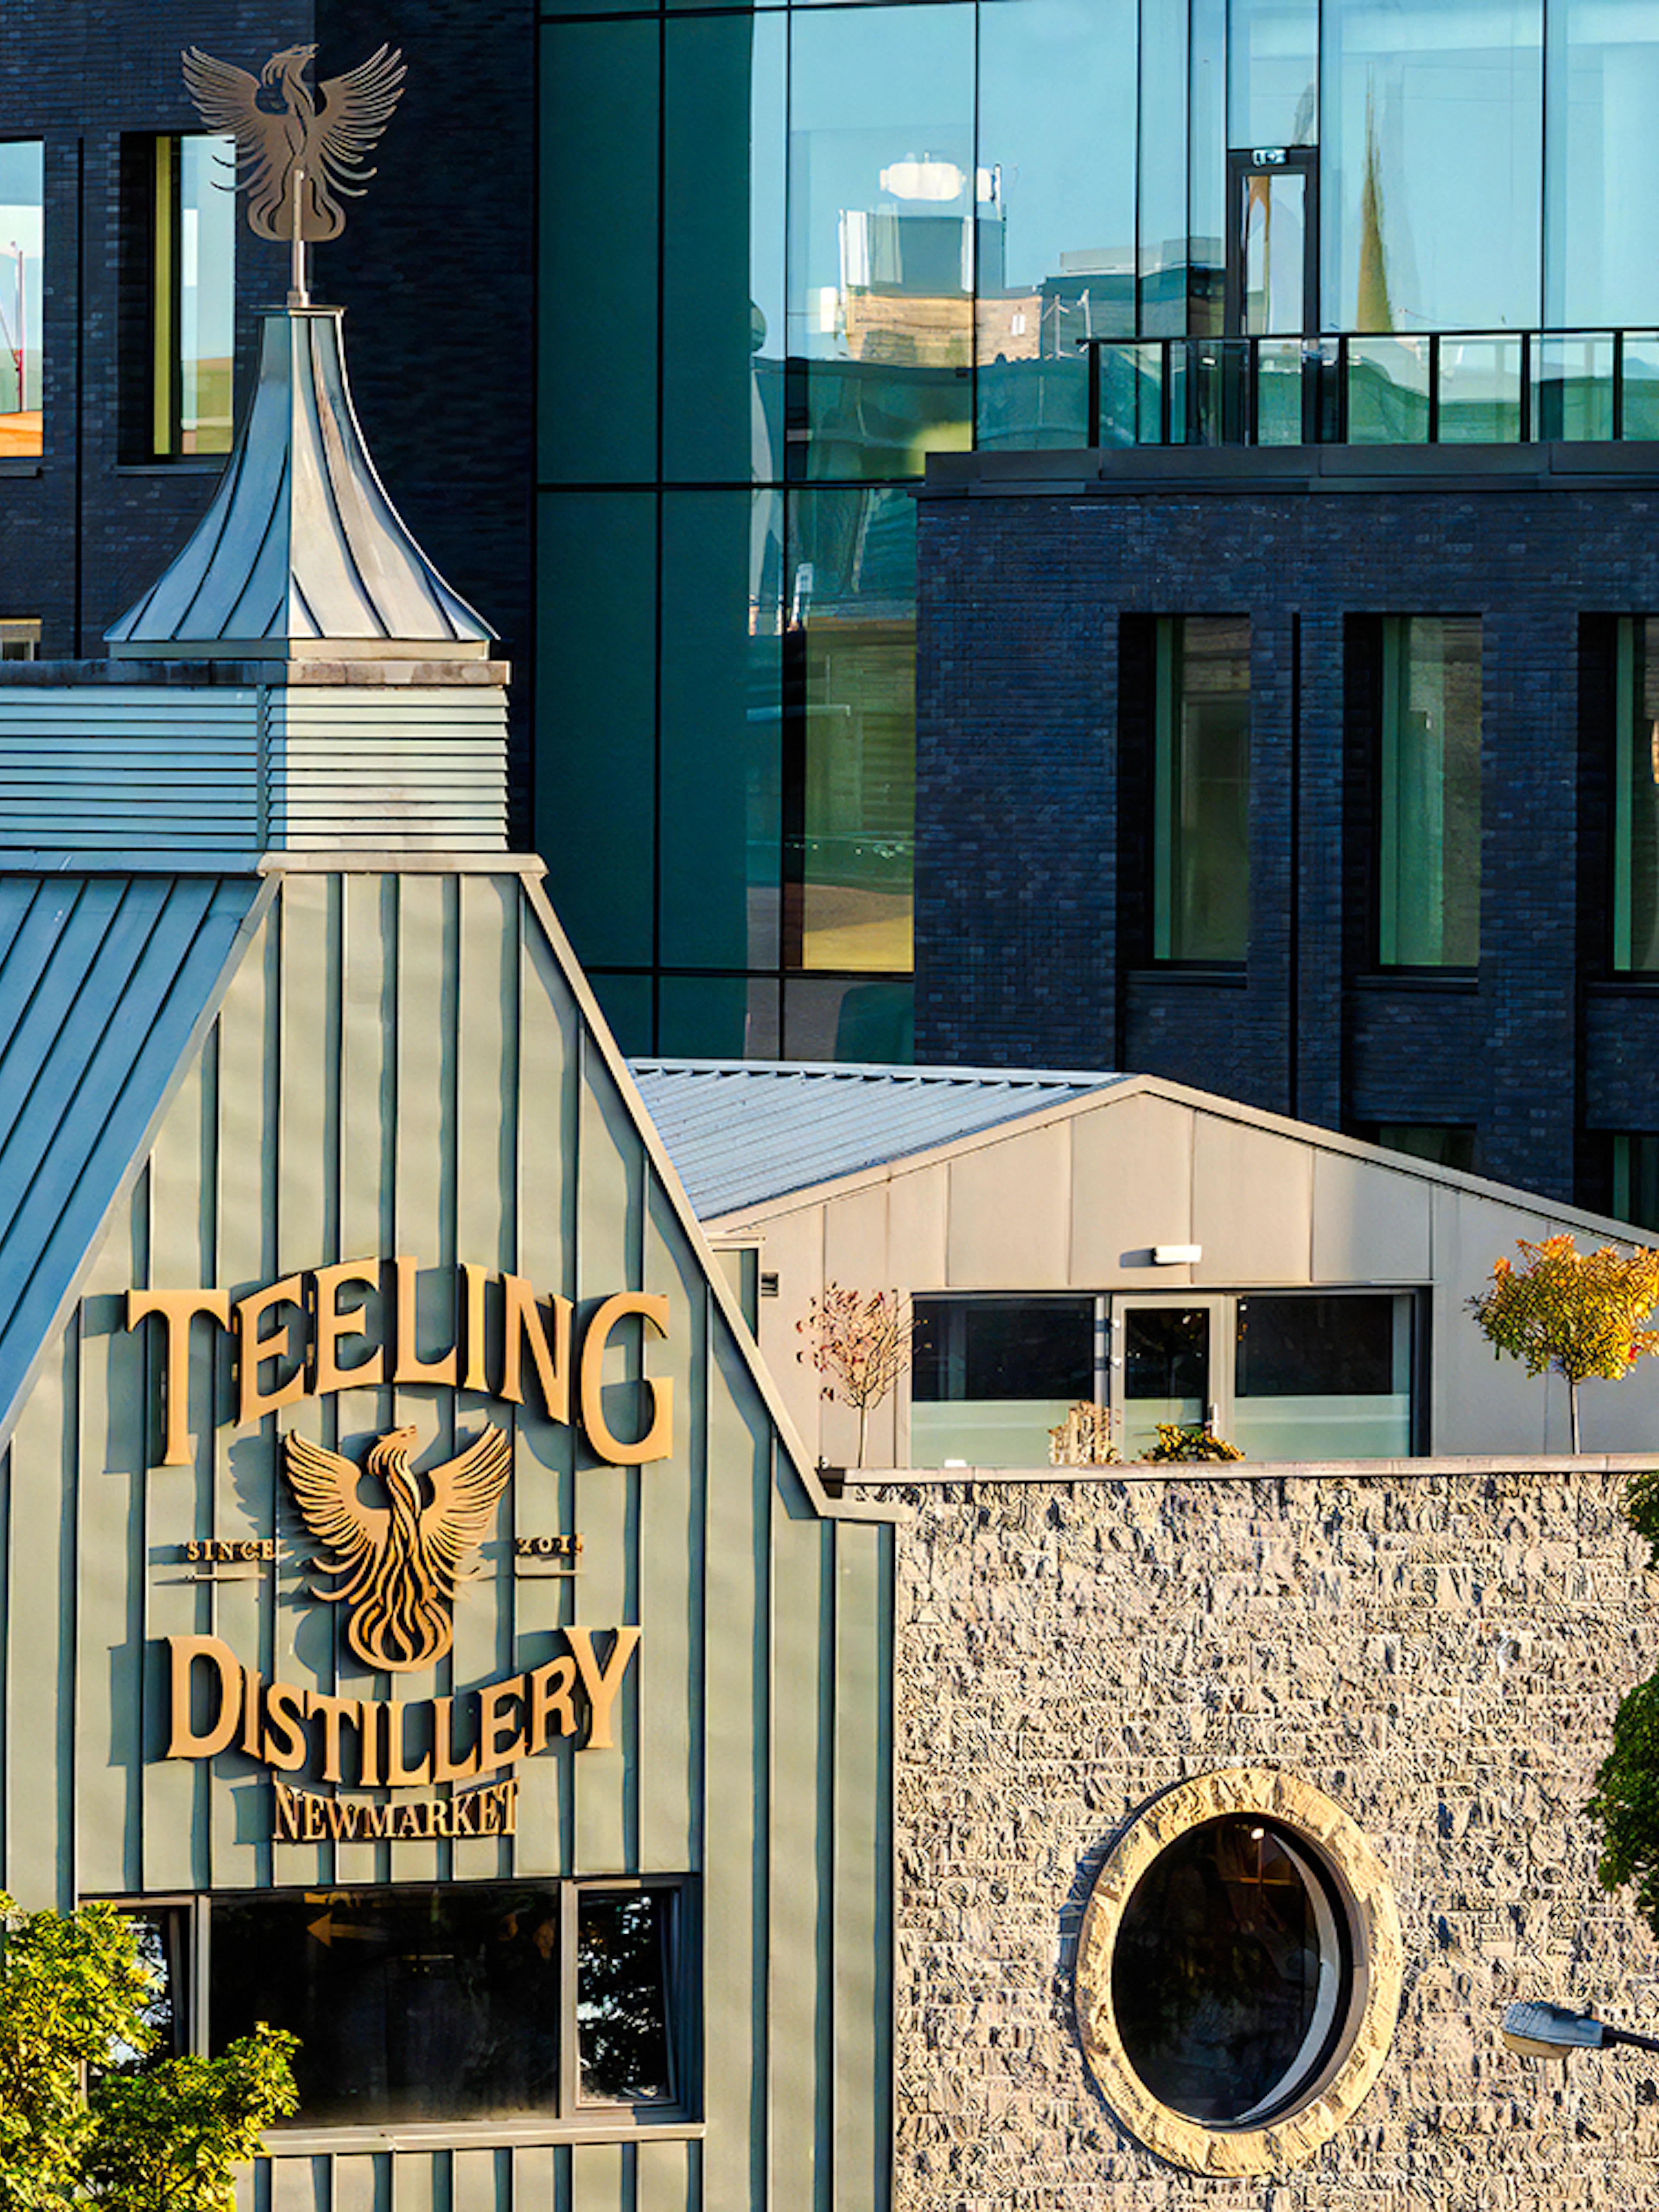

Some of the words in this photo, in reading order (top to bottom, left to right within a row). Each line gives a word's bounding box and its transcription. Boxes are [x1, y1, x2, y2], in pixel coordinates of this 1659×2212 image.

[127, 1256, 674, 1467] TEELING
[187, 1539, 276, 1561] SINCE
[167, 1626, 641, 1787] DISTILLERY
[272, 1777, 520, 1840] NEWMARKET
